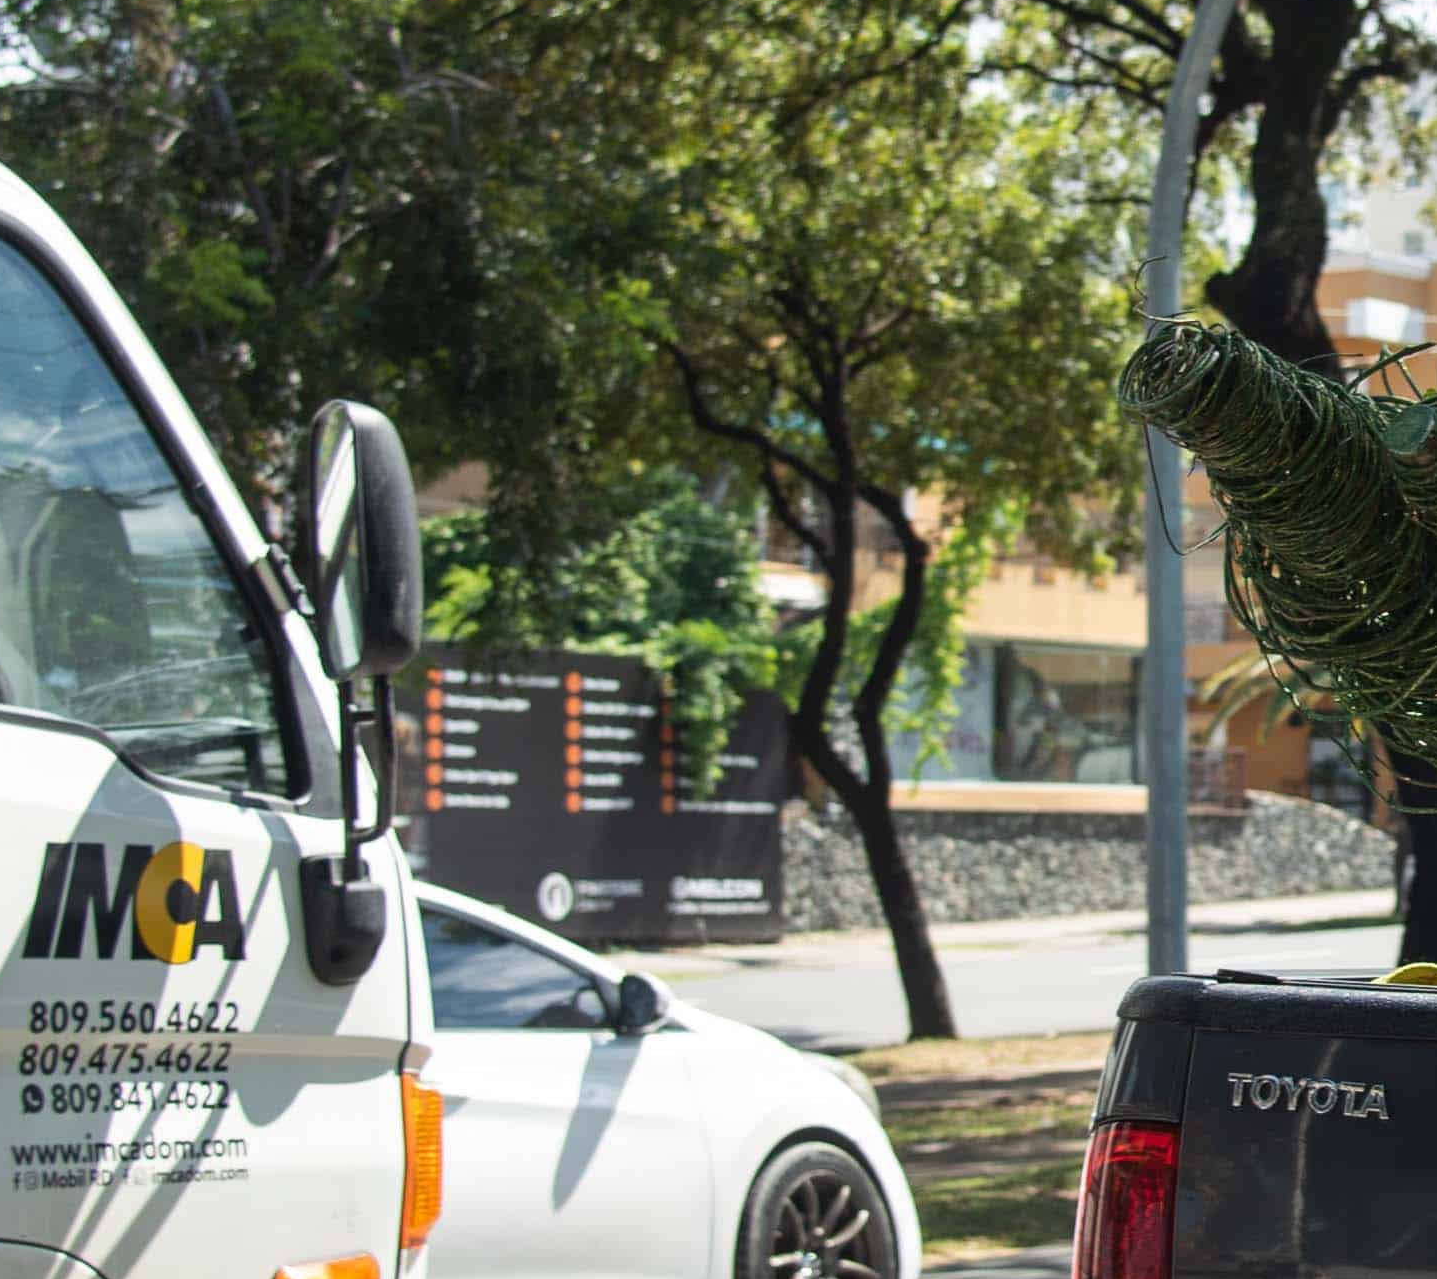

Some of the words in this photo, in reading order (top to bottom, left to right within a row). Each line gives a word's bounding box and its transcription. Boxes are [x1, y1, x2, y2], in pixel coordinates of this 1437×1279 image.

[22, 841, 246, 965] IMCA
[29, 1000, 239, 1034] 809.560.4622
[19, 1041, 232, 1076] 809.475.4622
[1227, 1072, 1390, 1120] TOYOTA
[11, 1133, 248, 1166] www.imcadom.com
